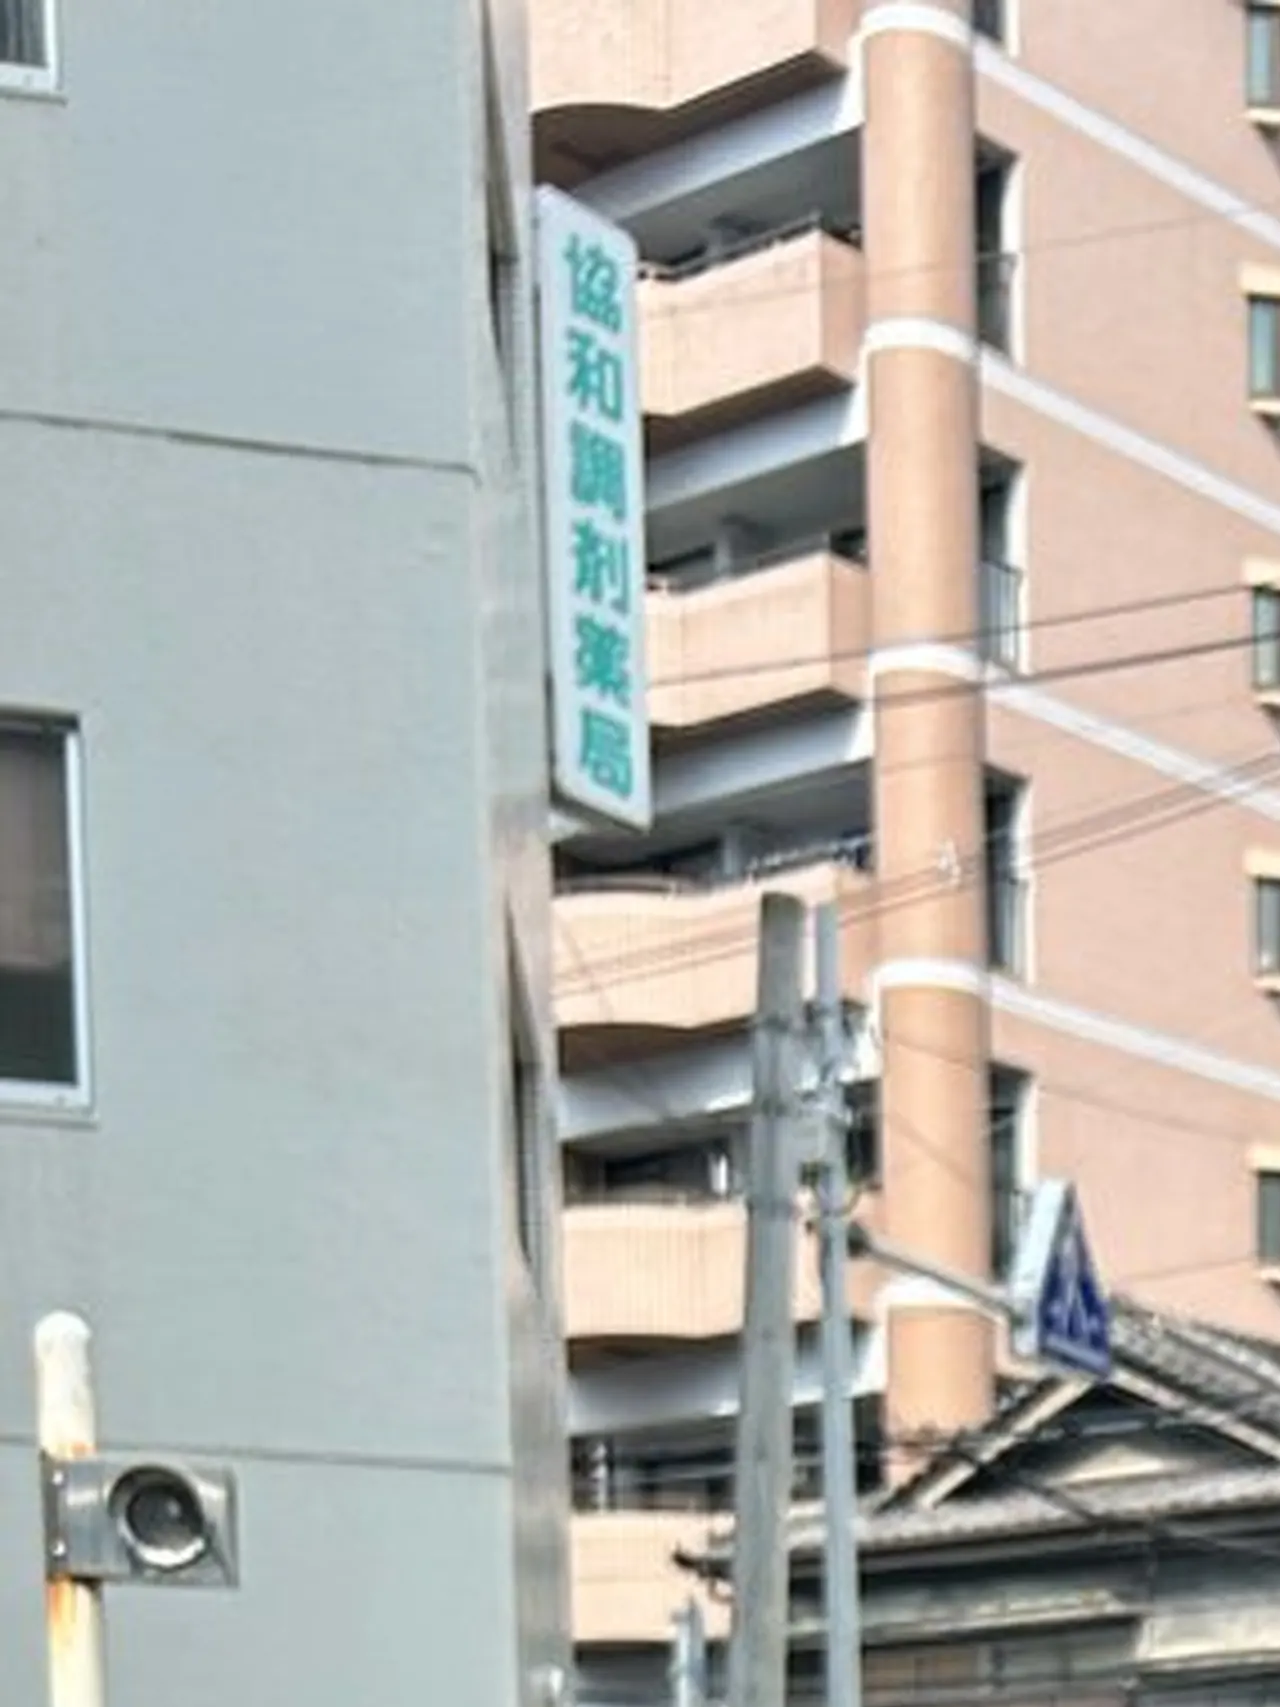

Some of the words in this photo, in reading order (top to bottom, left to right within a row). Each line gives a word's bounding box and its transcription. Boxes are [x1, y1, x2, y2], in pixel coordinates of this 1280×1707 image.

[563, 232, 633, 800] 協和調剤薬局
